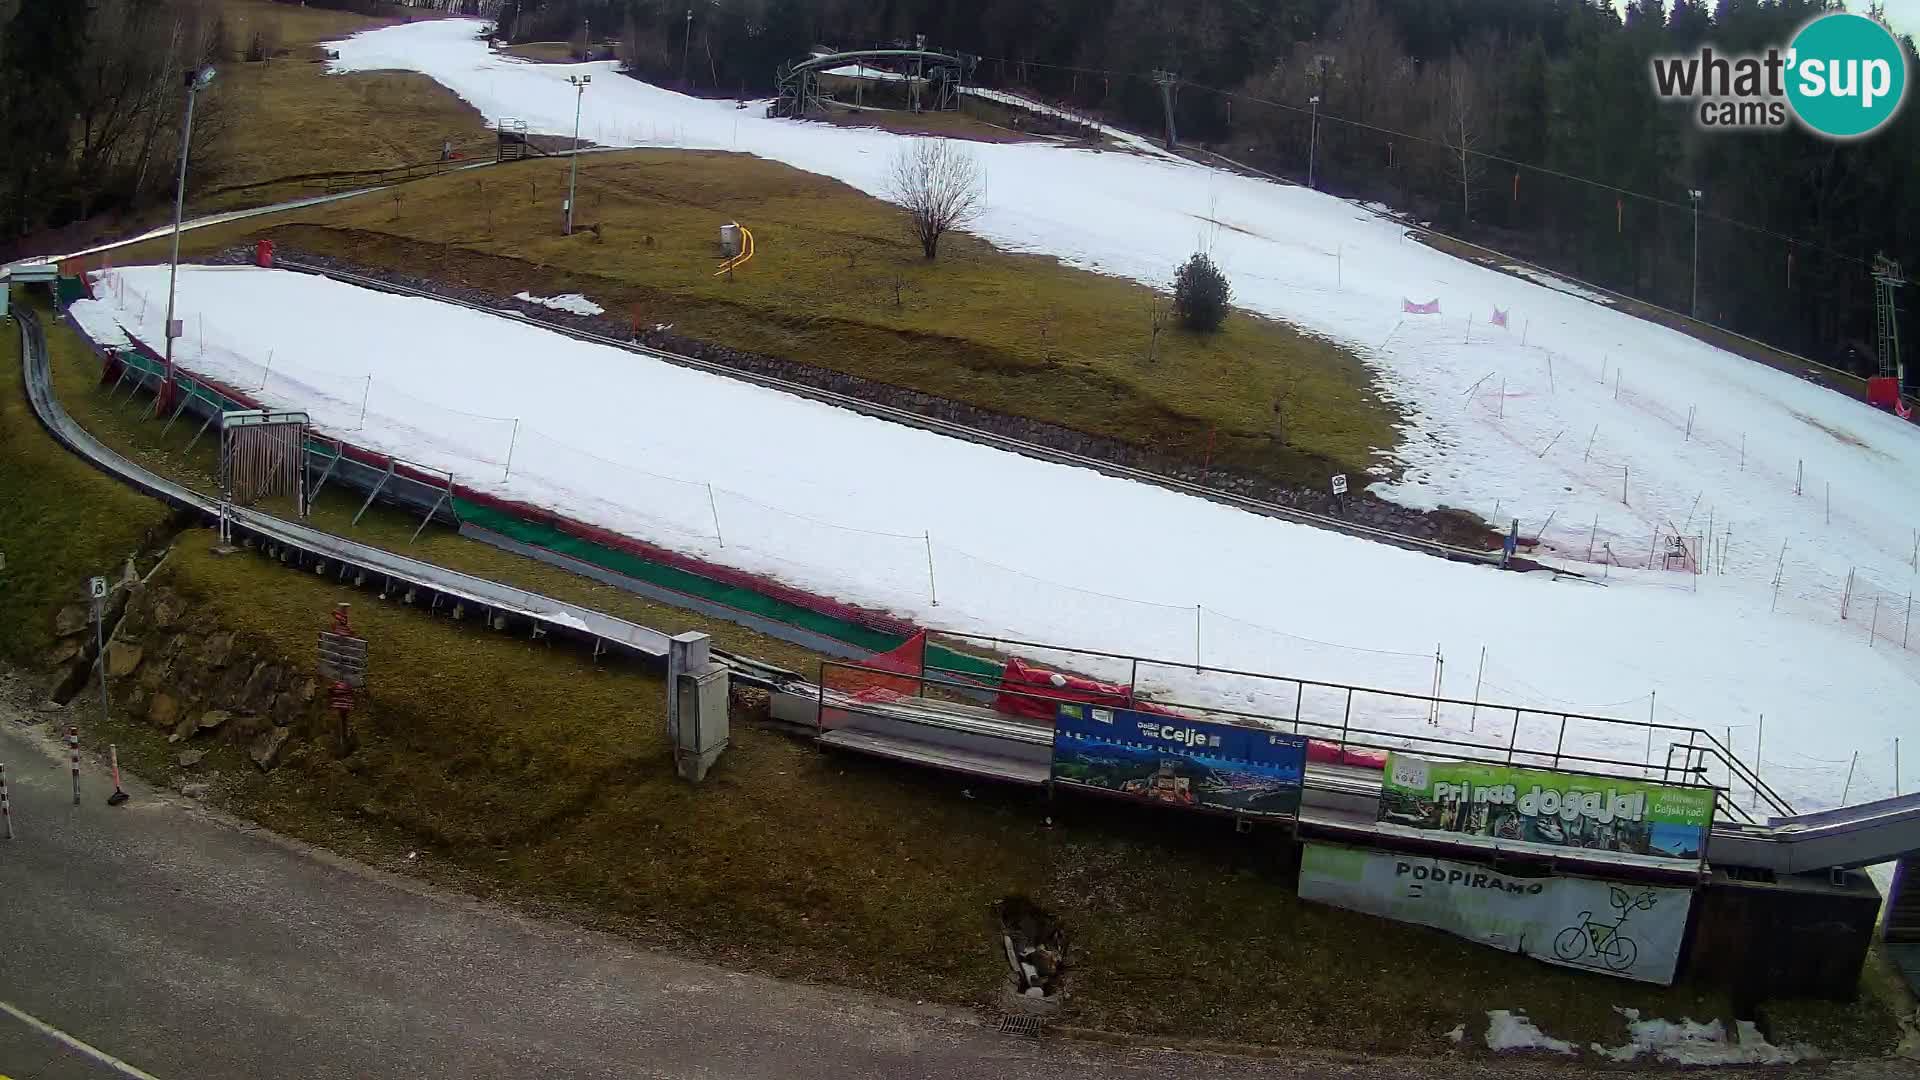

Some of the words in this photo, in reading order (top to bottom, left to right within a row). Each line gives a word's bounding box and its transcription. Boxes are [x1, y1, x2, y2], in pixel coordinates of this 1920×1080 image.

[1161, 725, 1207, 747] Celje
[1474, 784, 1516, 805] nas
[1517, 784, 1646, 824] dogaja!
[1395, 861, 1544, 895] PODPIRAMO
